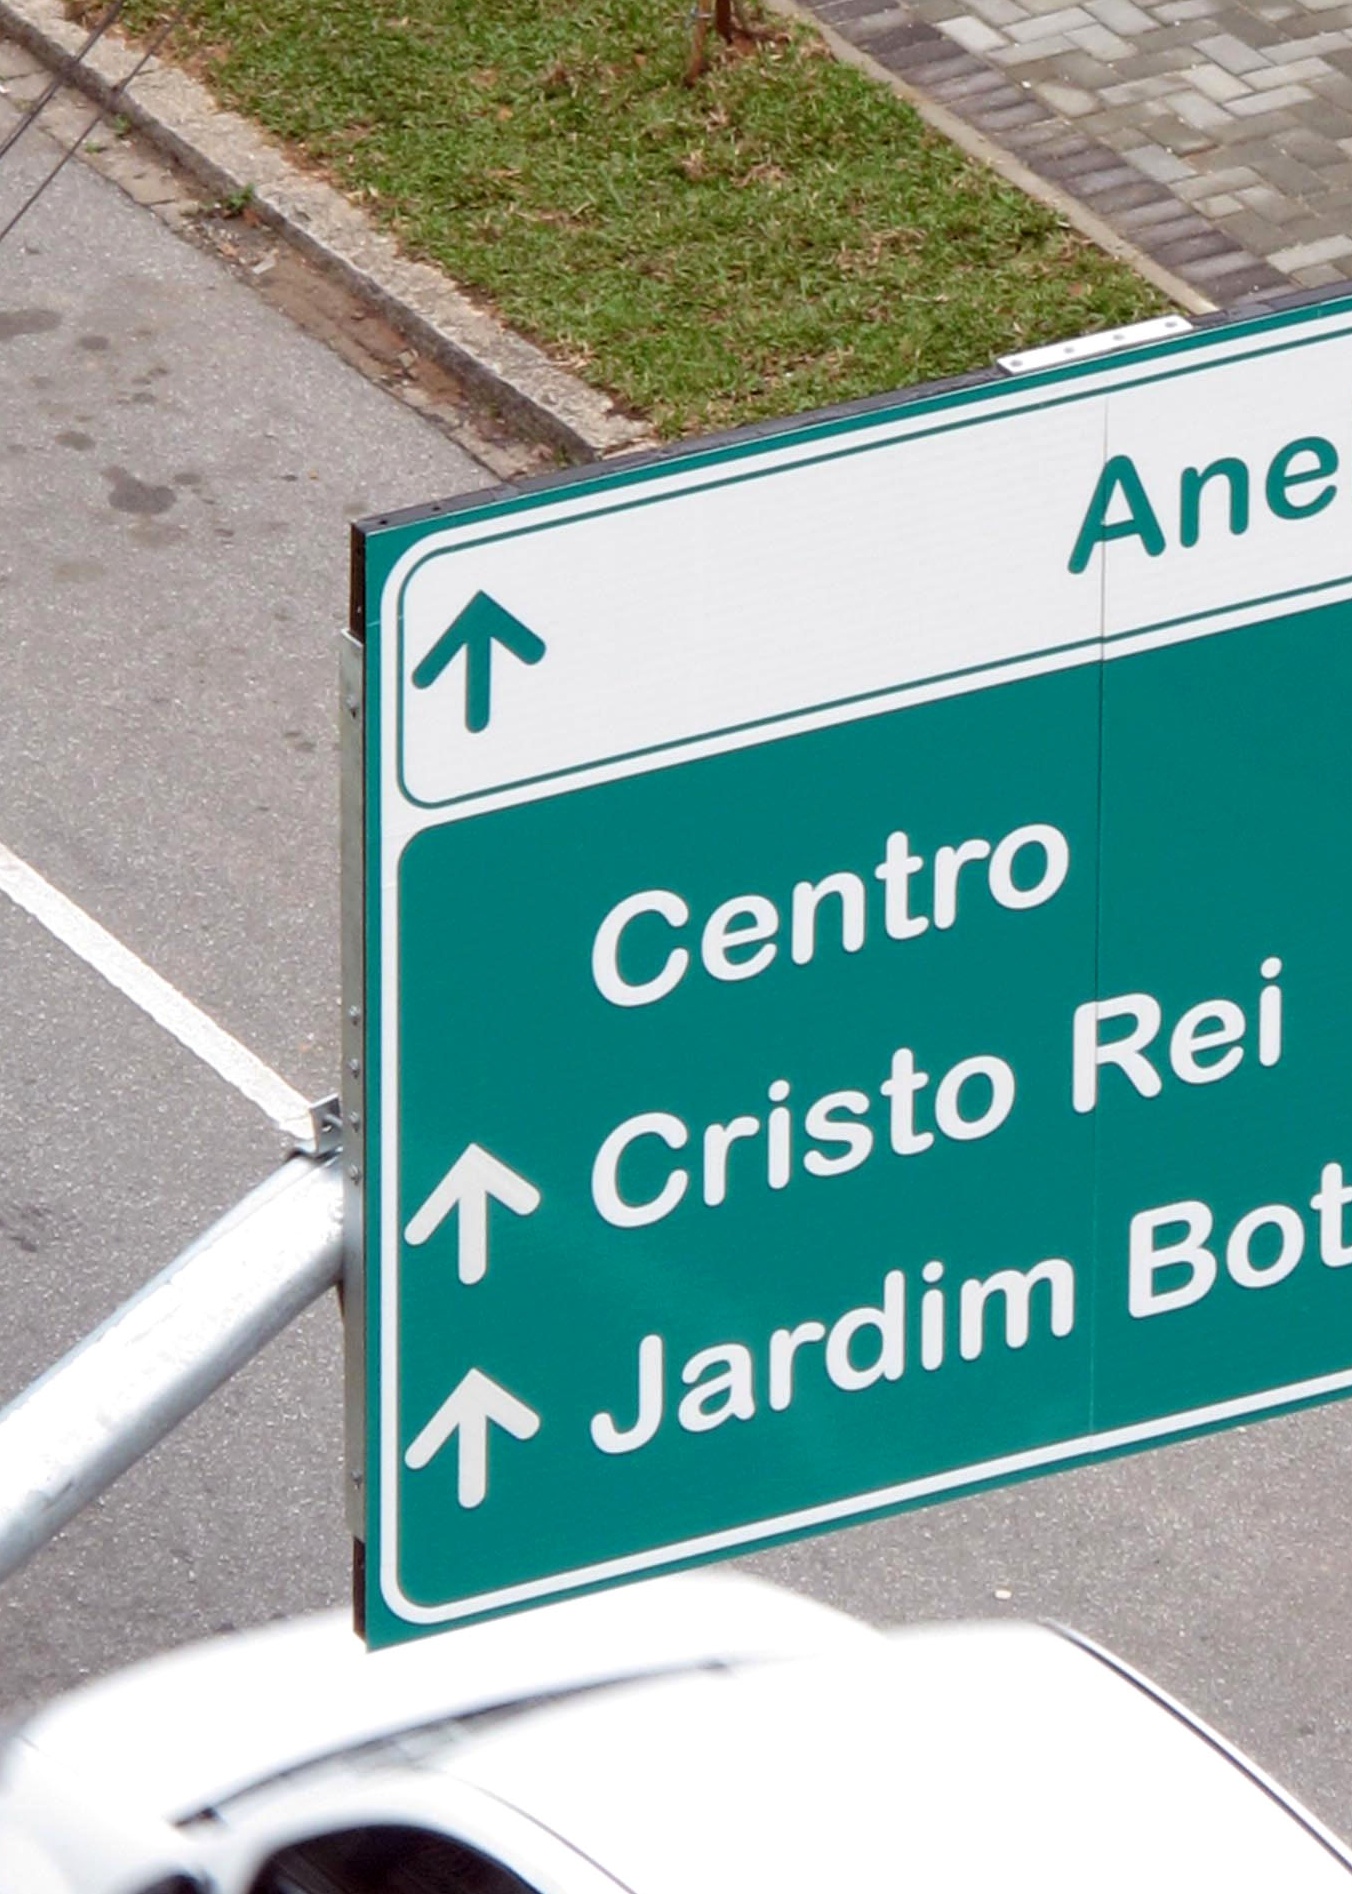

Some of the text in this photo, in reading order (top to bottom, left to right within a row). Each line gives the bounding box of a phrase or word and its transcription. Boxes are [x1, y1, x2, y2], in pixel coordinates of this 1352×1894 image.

[592, 823, 1070, 1007] Centro
[591, 1047, 1016, 1228] Cristo
[1072, 956, 1282, 1113] Rei
[590, 1258, 1075, 1454] Jardim
